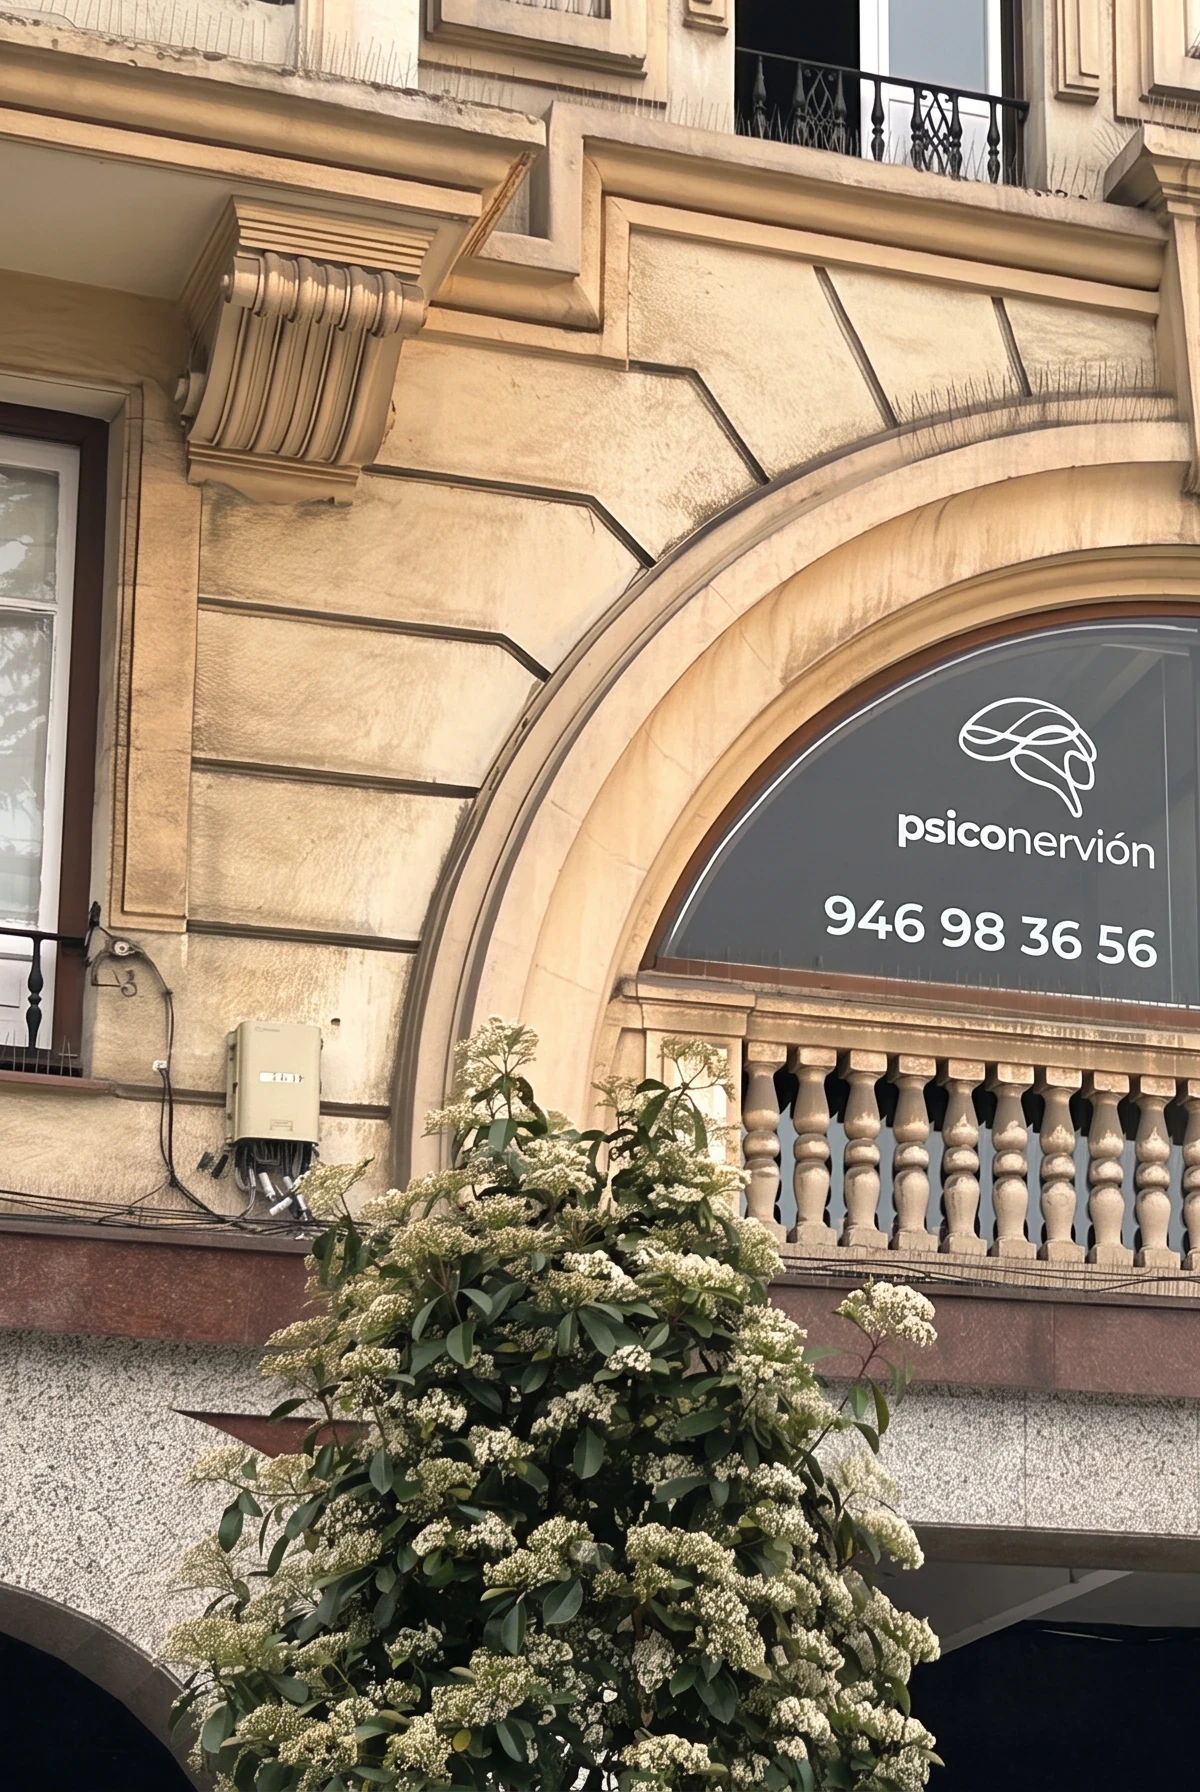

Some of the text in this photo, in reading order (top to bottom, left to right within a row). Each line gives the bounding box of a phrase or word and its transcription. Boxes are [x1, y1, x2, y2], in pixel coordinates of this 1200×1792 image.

[898, 809, 1156, 870] psiconervión
[824, 895, 1158, 968] 946 98 36 56
